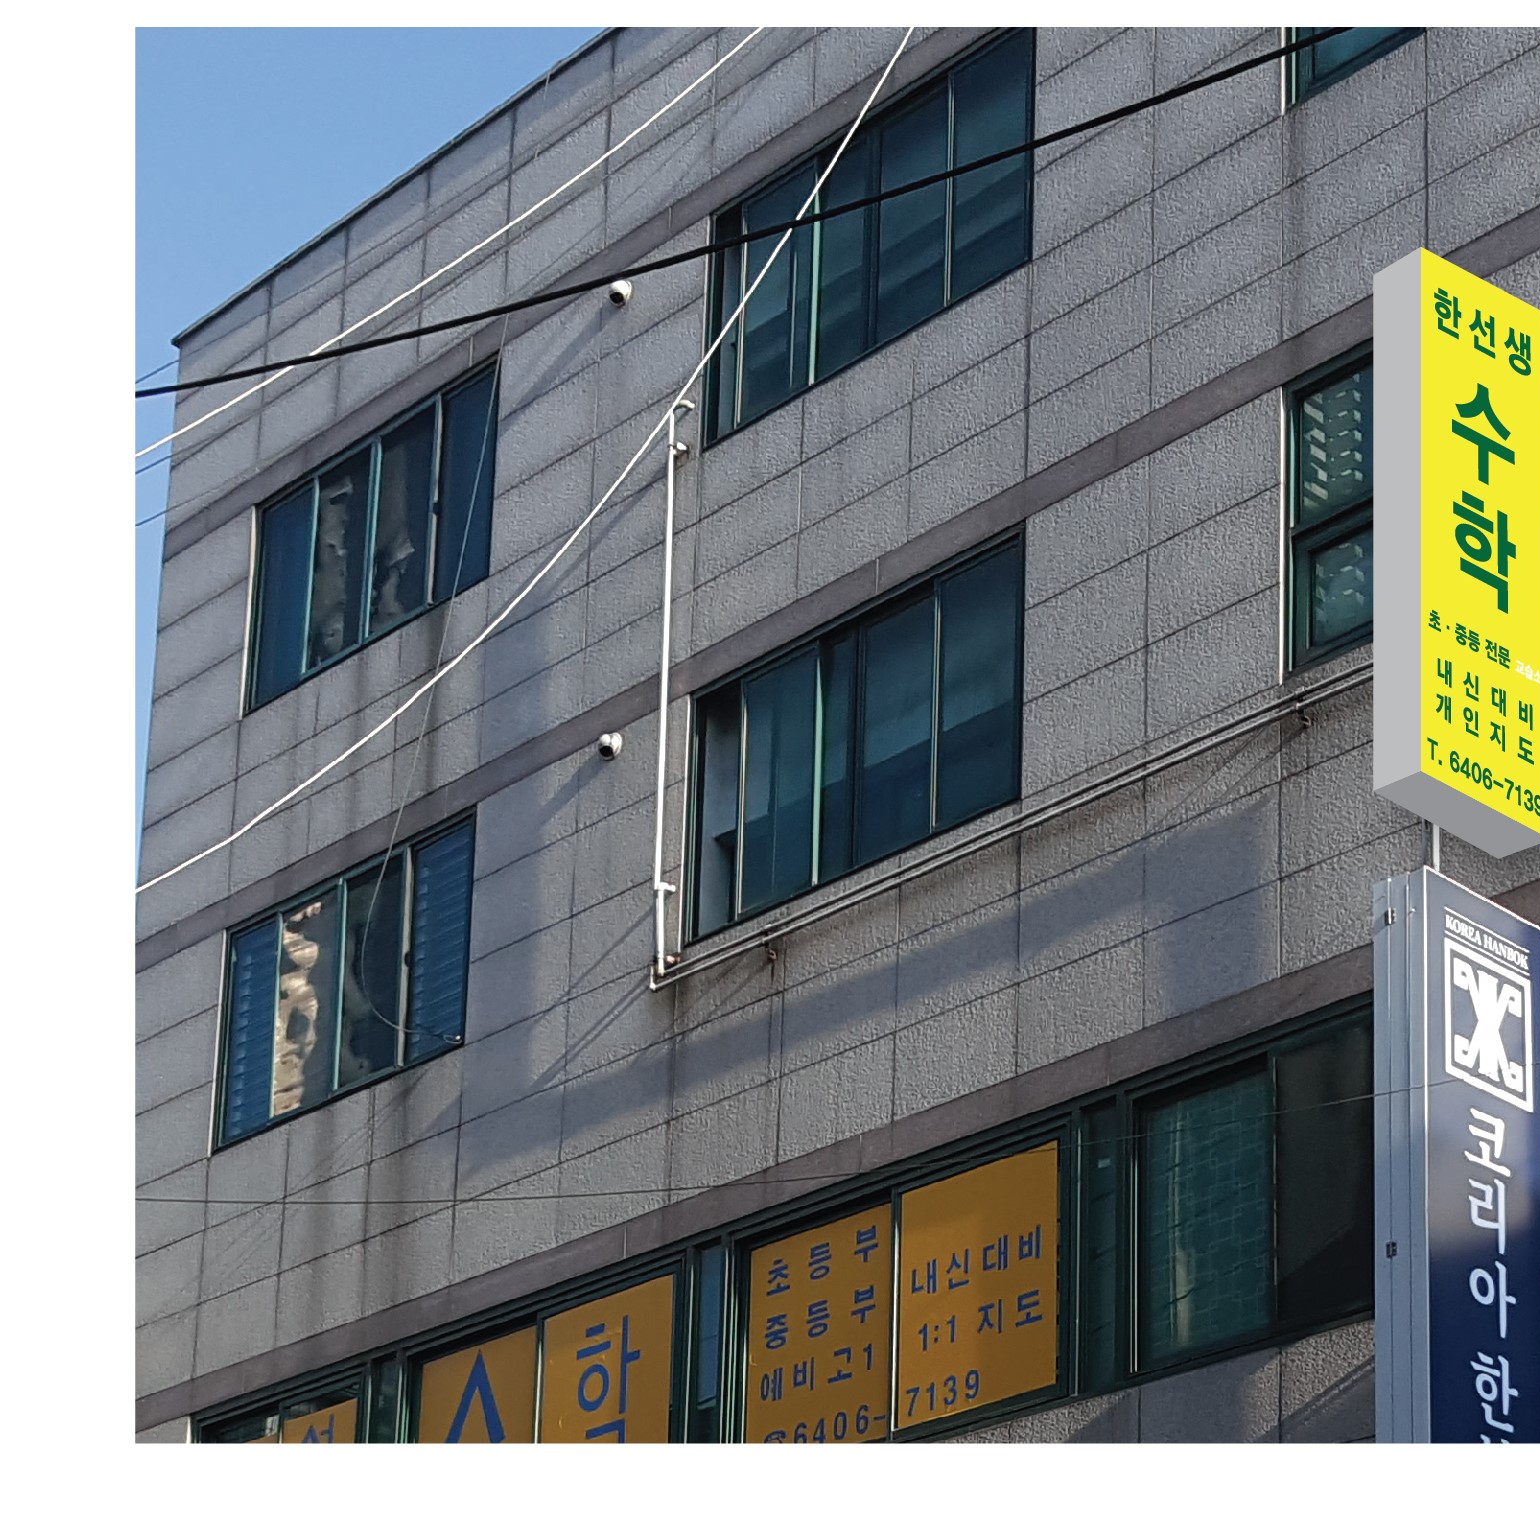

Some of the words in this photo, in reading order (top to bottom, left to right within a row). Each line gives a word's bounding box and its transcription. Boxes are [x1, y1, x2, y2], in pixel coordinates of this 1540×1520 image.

[1433, 287, 1533, 377] 한선생
[1451, 382, 1517, 615] 수학
[1484, 638, 1511, 670] 전문
[1445, 914, 1482, 946] KOREA
[1483, 934, 1529, 970] HANBOK
[1463, 1107, 1517, 1339] 코리아
[766, 1225, 878, 1297] 초등부
[911, 1224, 1042, 1295] 내신대비
[764, 1284, 877, 1350] 중등부
[917, 1314, 957, 1352] 1:1
[976, 1289, 1043, 1334] 지도
